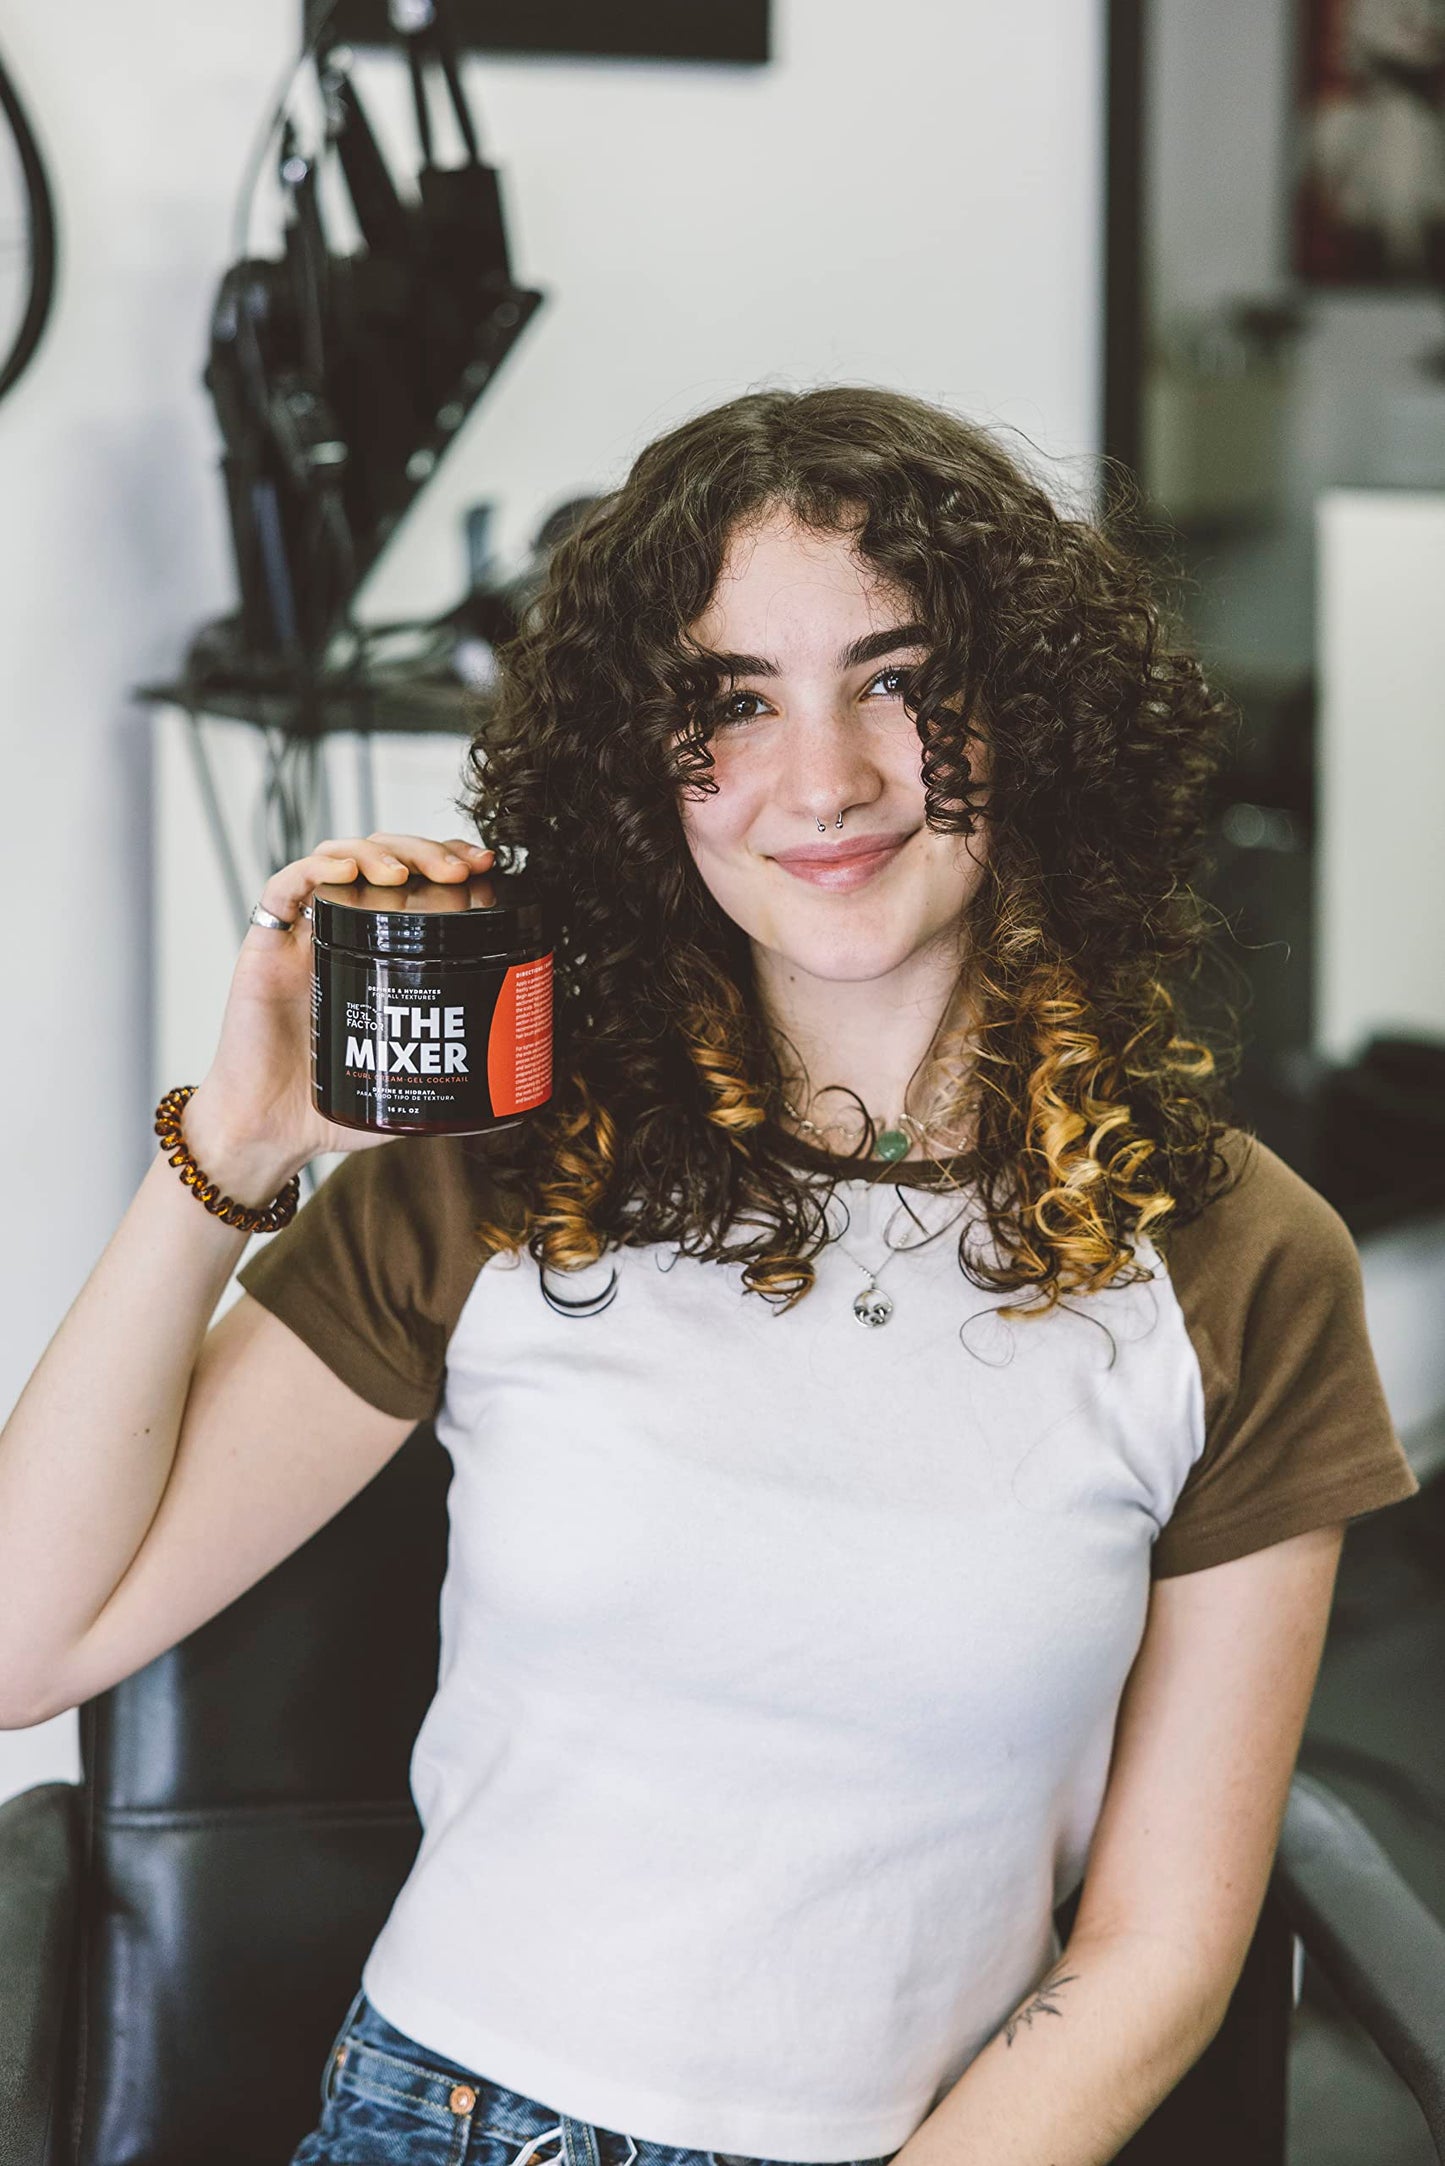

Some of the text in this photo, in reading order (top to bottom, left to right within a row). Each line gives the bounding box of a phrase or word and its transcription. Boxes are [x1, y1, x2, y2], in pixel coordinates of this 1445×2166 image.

[346, 1001, 360, 1010] THE
[346, 1009, 372, 1021] CURL
[346, 1018, 384, 1032] FACTOR
[384, 1006, 465, 1038] THE
[345, 1036, 469, 1074] MIXER
[345, 1069, 351, 1077] A
[352, 1071, 372, 1081] CURL
[356, 1089, 373, 1098] PARA
[374, 1092, 392, 1100] TODO
